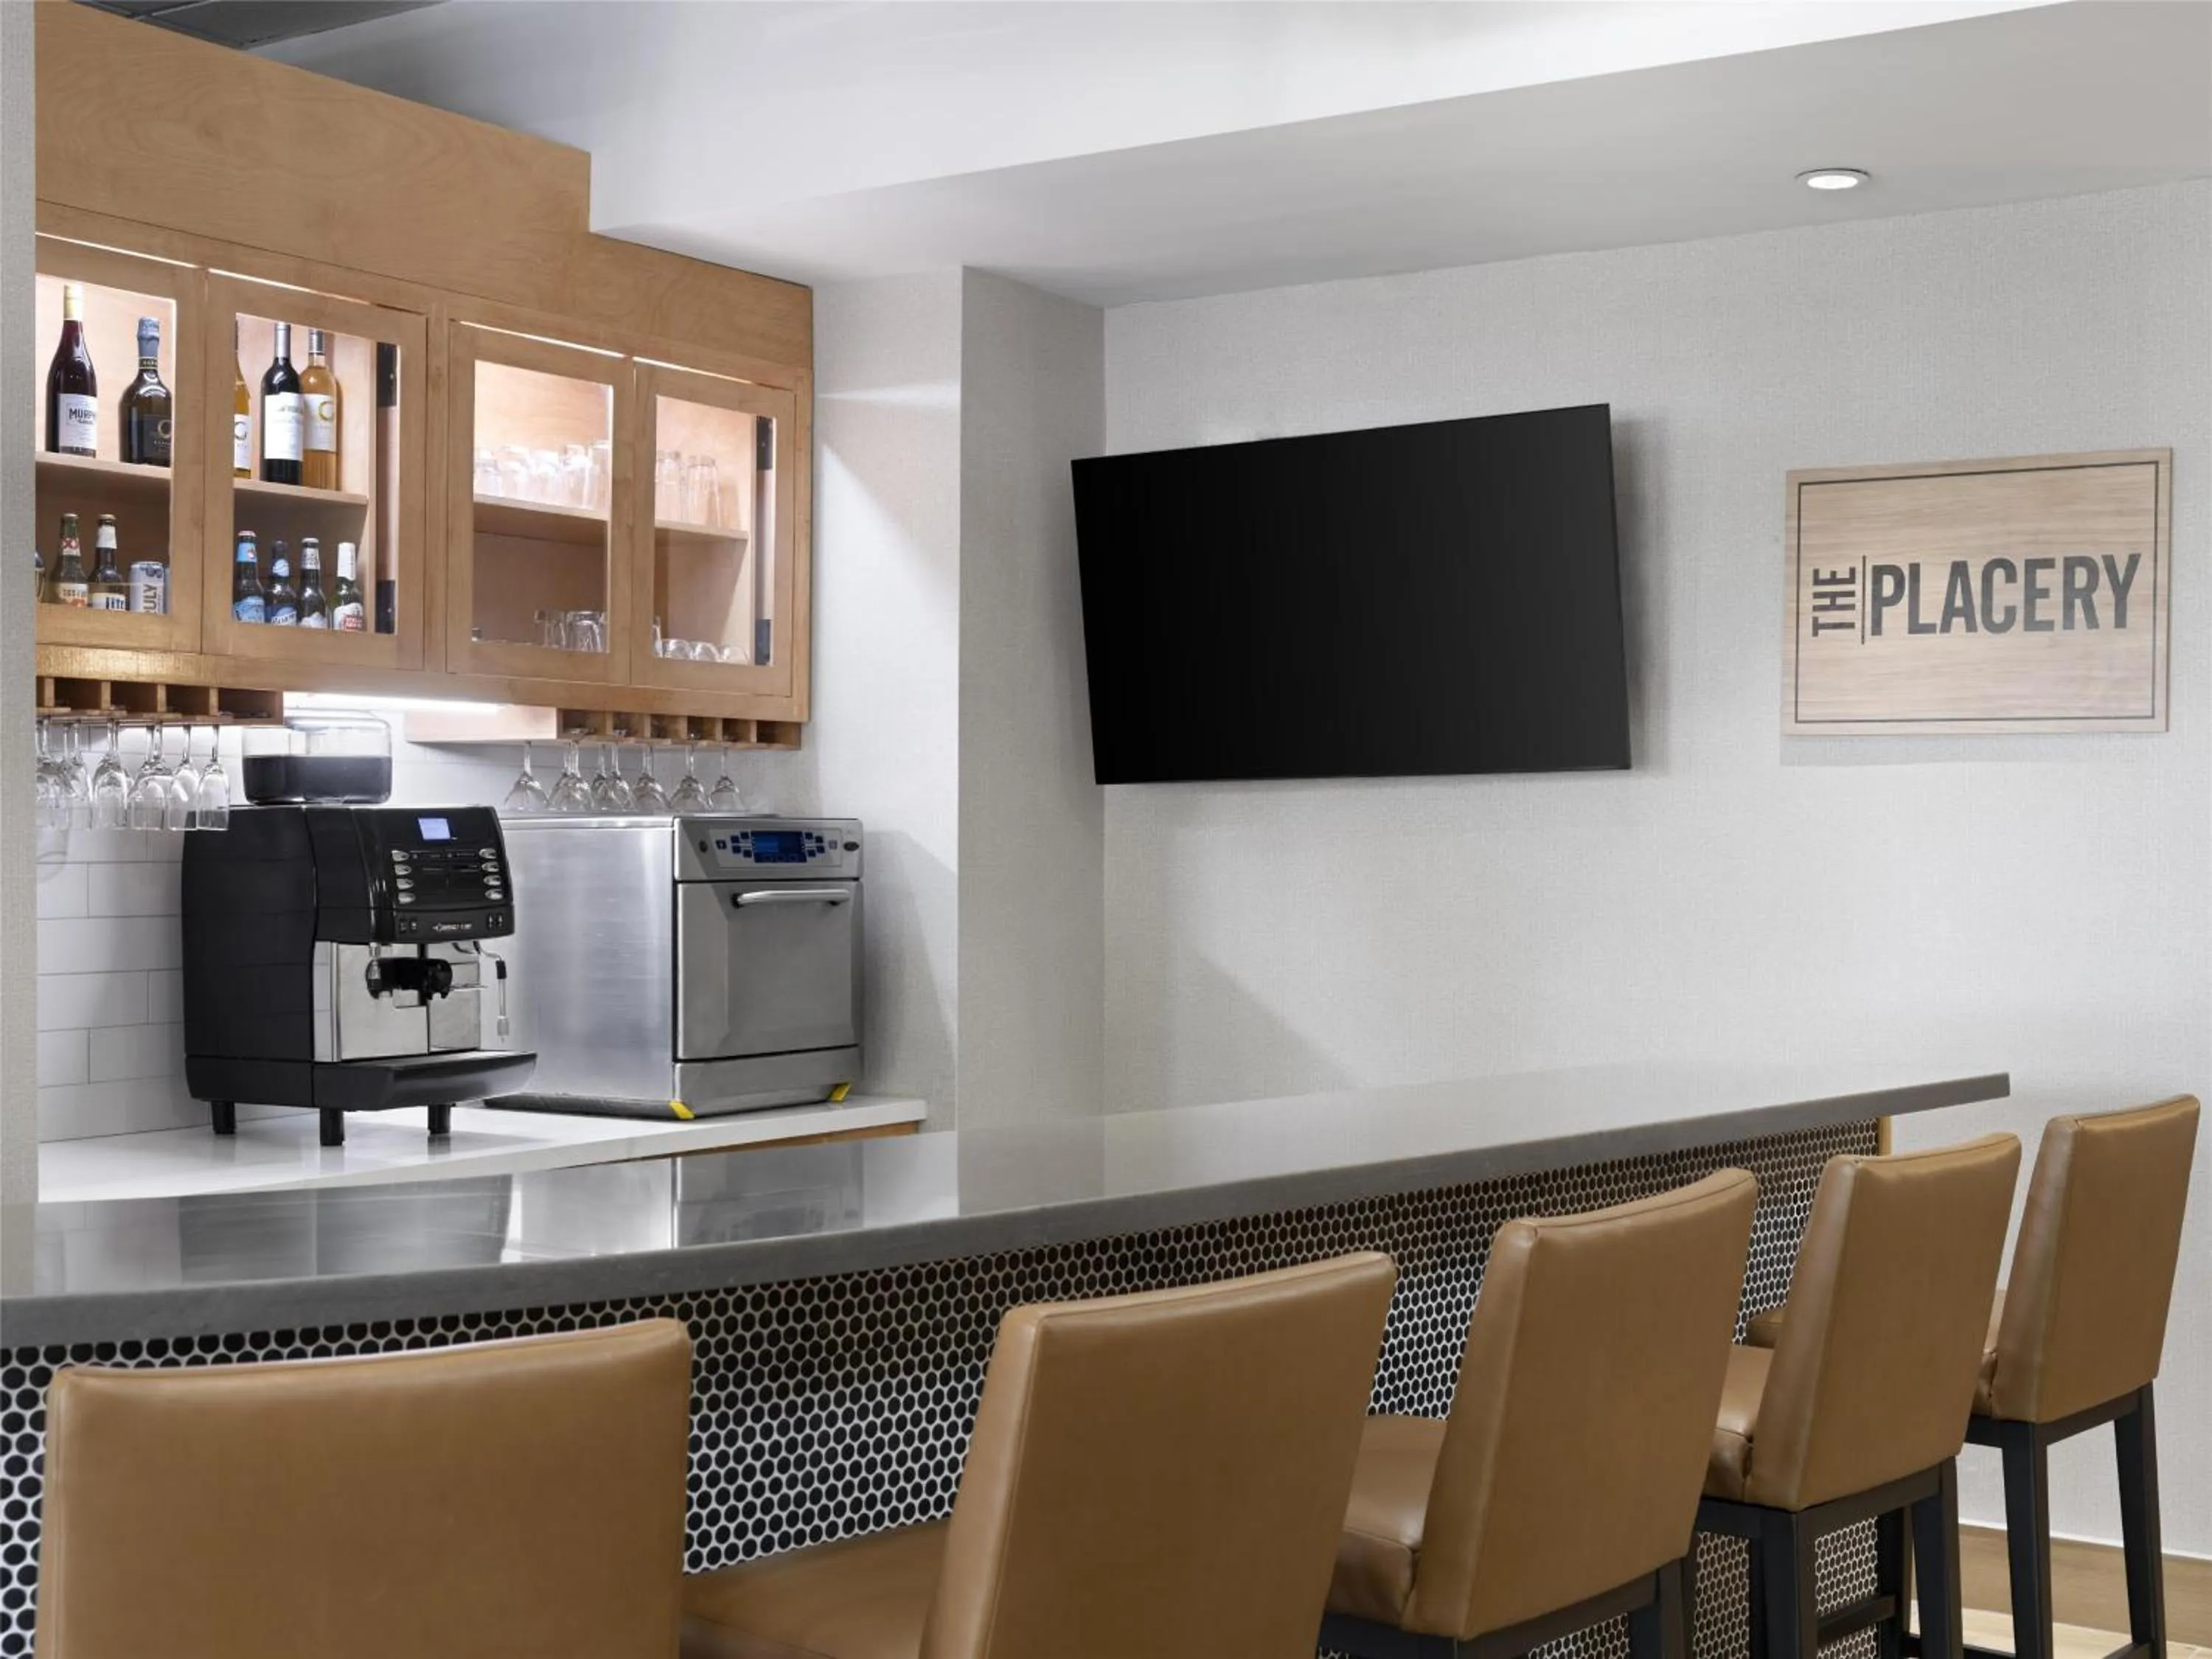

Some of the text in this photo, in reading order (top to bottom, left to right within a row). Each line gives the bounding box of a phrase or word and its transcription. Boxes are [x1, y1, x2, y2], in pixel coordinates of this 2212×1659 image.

[143, 584, 157, 613] ULY
[1812, 566, 1856, 637] THE
[1871, 553, 2141, 636] PLACERY
